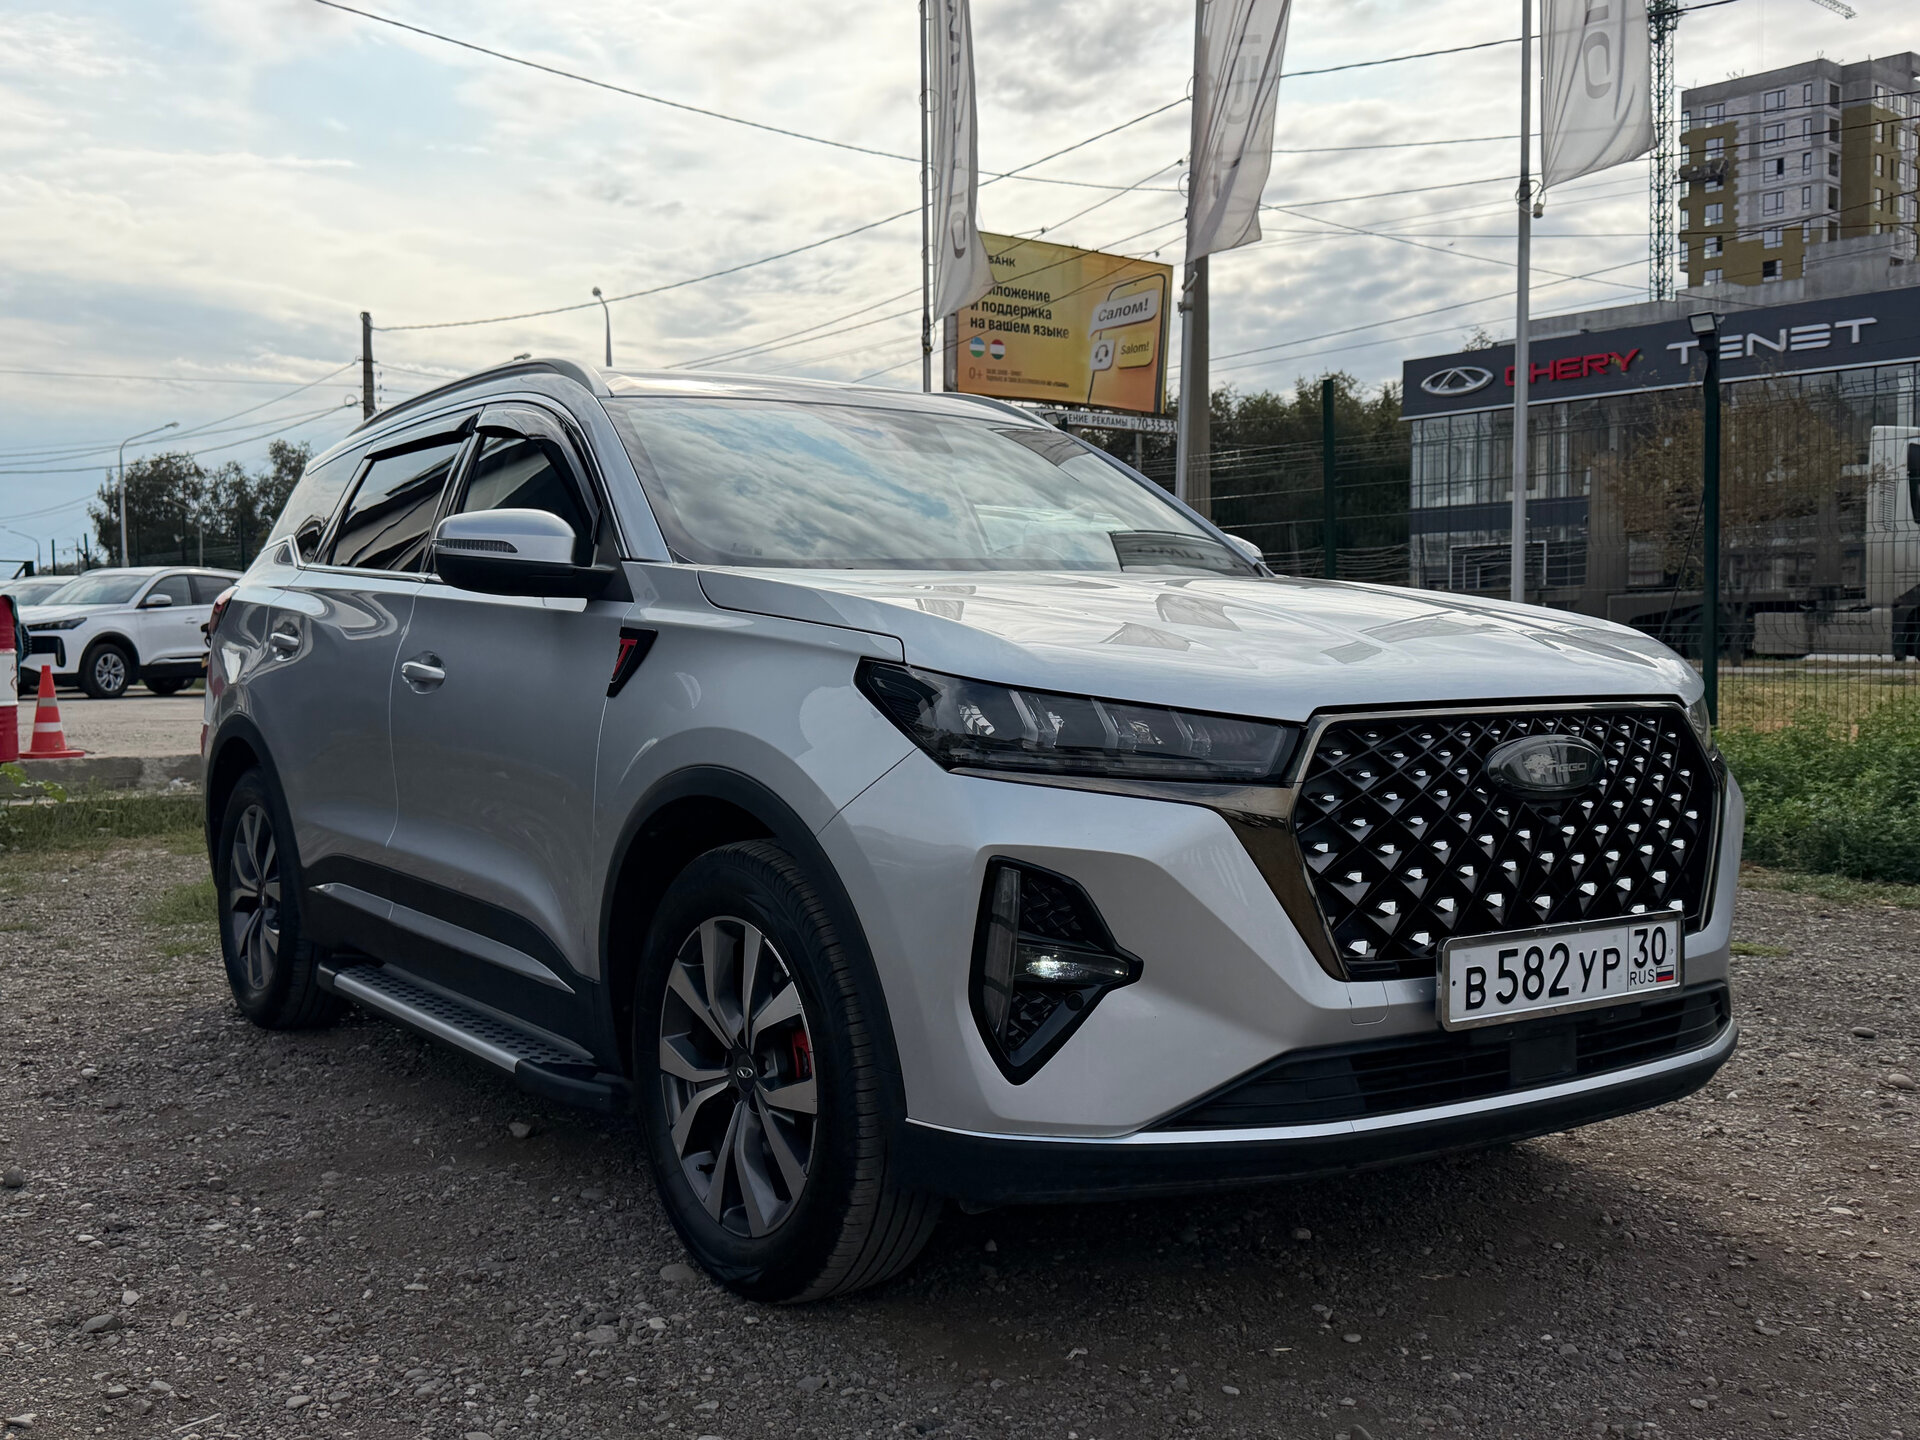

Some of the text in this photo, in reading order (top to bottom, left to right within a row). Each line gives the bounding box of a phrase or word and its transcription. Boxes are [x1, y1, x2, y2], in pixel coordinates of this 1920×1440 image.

[988, 255, 1016, 267] БАНК
[988, 285, 1051, 303] иложение
[981, 302, 1052, 320] поддержка
[1098, 298, 1149, 322] Салом!
[970, 317, 1069, 339] на вашем языке
[1120, 341, 1150, 355] Salom!
[1666, 317, 1878, 365] TENET
[1091, 415, 1128, 427] РЕКЛАМЫ
[1136, 418, 1175, 432] 70-33-33
[1547, 762, 1587, 774] TIGGO
[1633, 926, 1667, 969] 30
[1629, 968, 1655, 987] RUS
